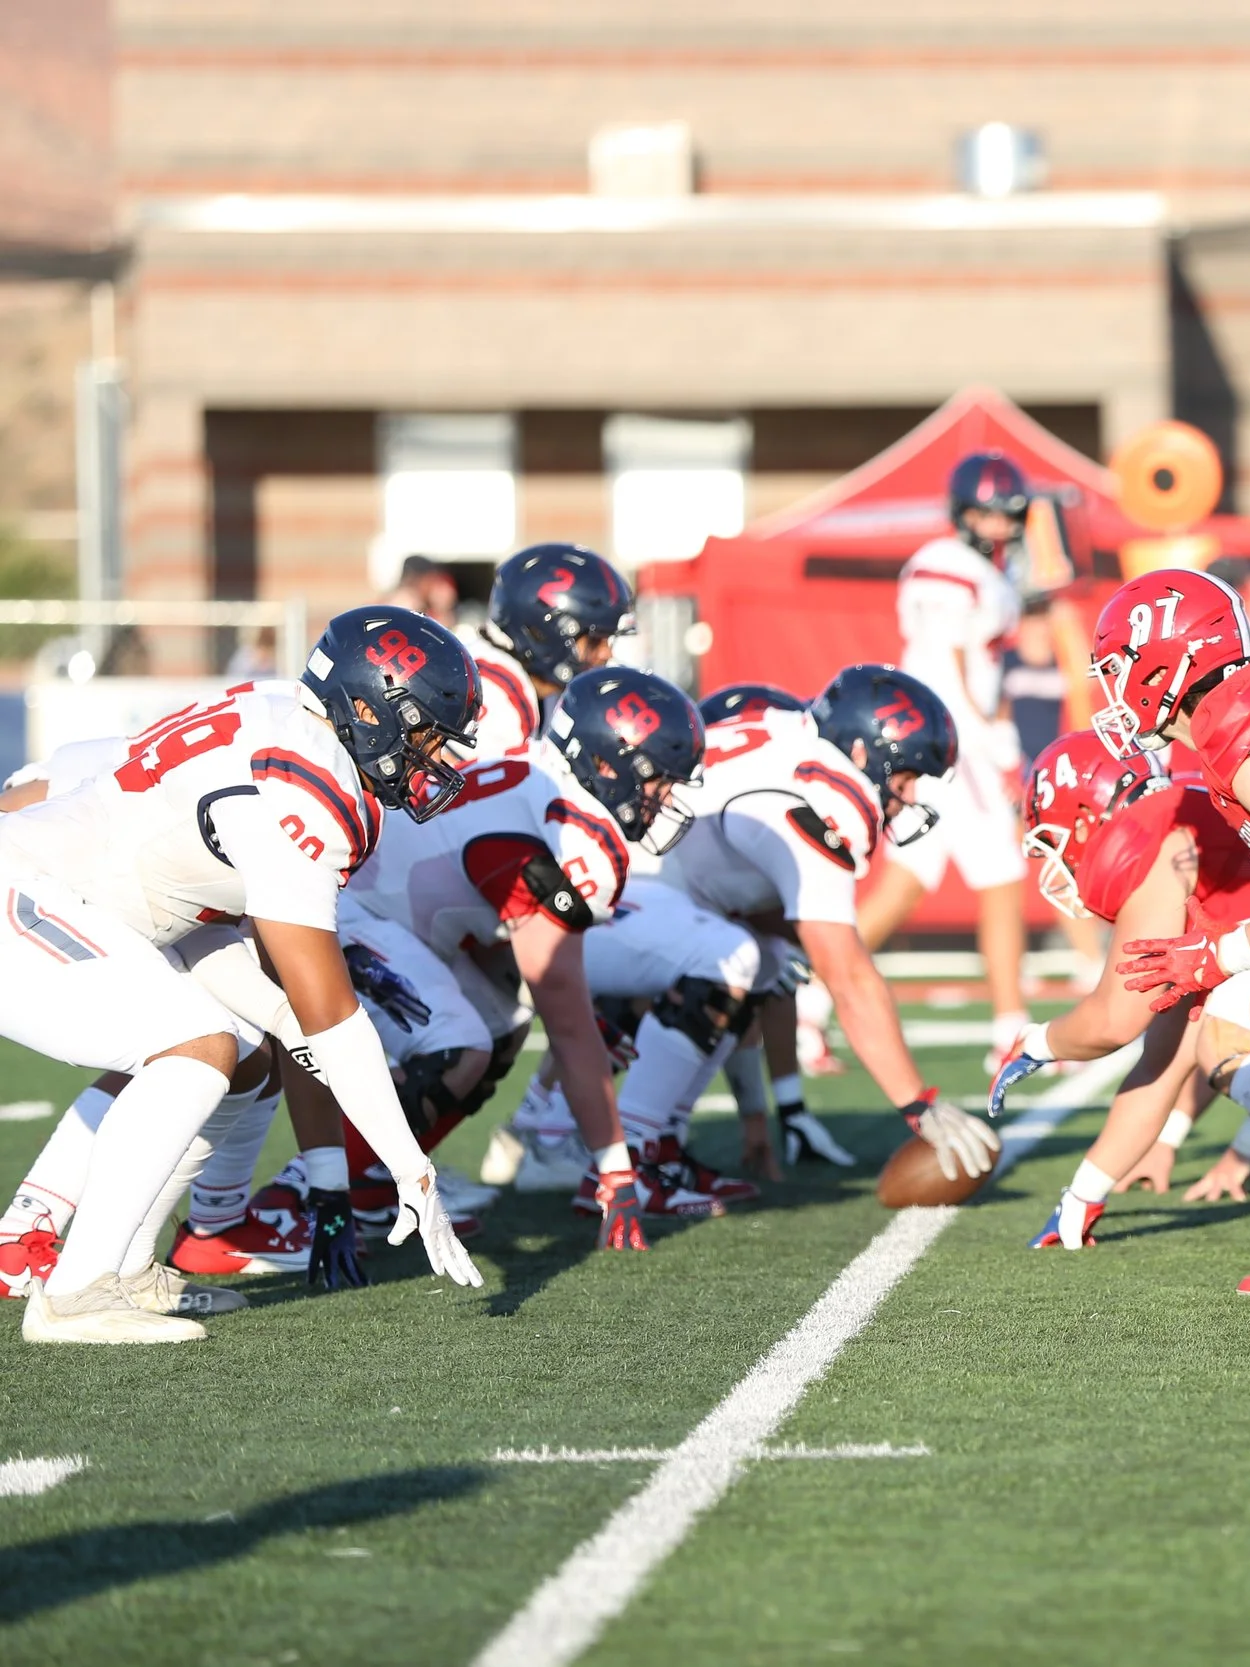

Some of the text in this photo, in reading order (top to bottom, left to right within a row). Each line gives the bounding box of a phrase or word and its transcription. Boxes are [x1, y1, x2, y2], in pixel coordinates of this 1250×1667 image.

[536, 567, 576, 610] 2
[1128, 596, 1179, 647] 97
[1037, 753, 1078, 810] 54
